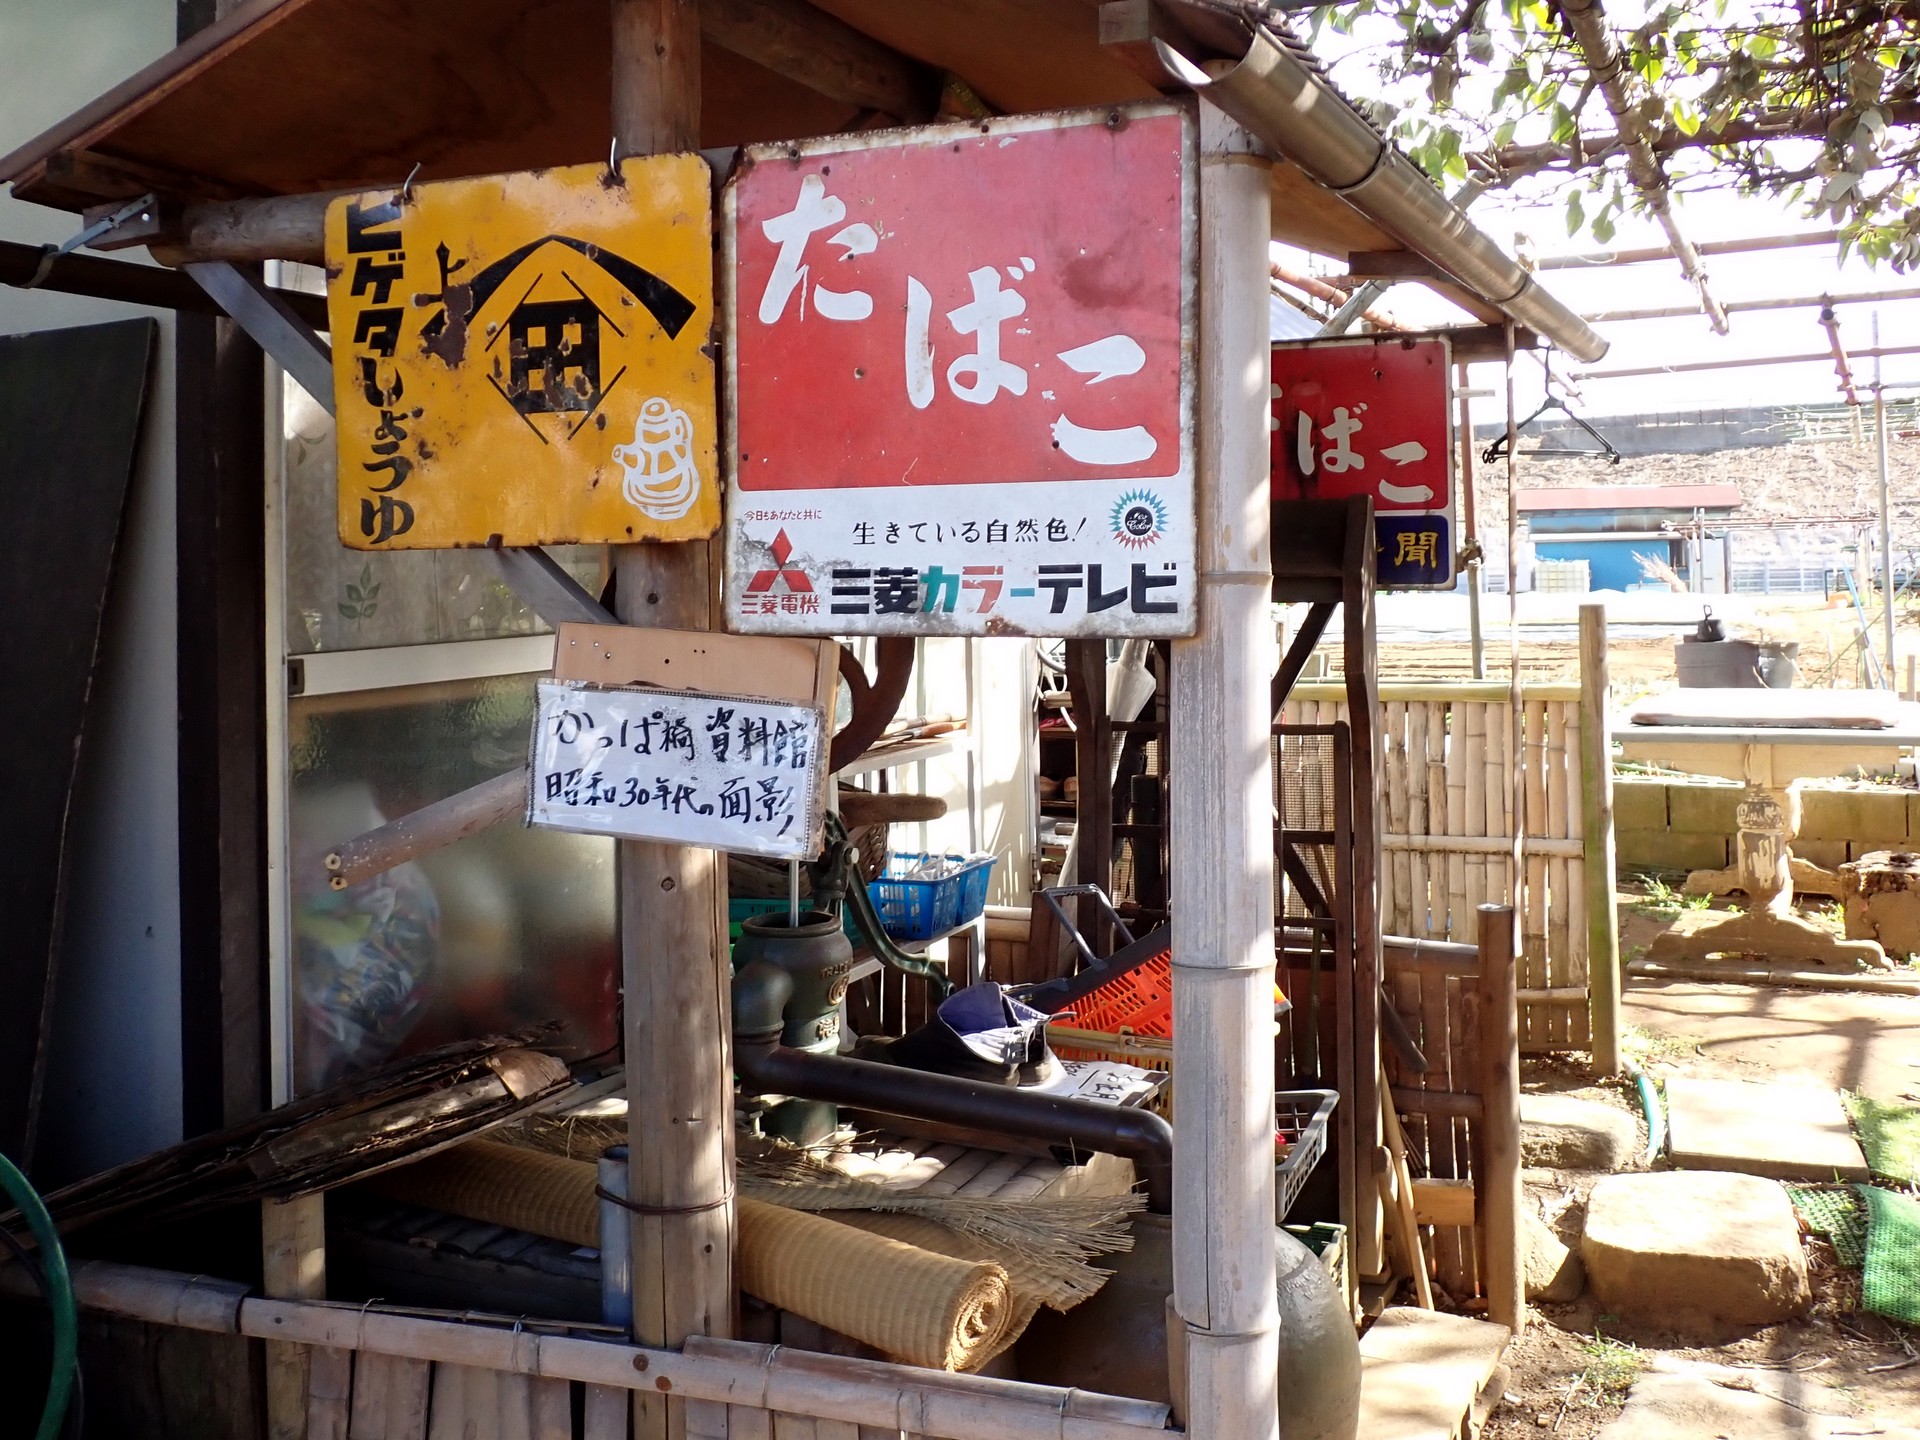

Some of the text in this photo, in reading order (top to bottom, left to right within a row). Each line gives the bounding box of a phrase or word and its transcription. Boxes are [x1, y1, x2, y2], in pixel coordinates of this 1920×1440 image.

[758, 173, 1158, 465] たばこ
[345, 202, 415, 545] ヒゲタしょうゆ
[1271, 382, 1435, 503] ばこ
[744, 509, 822, 521] 今日もあなたと共に
[1376, 531, 1439, 569] 聞
[741, 594, 820, 615] 三菱電機
[830, 562, 1179, 616] 三菱カラーテレビ
